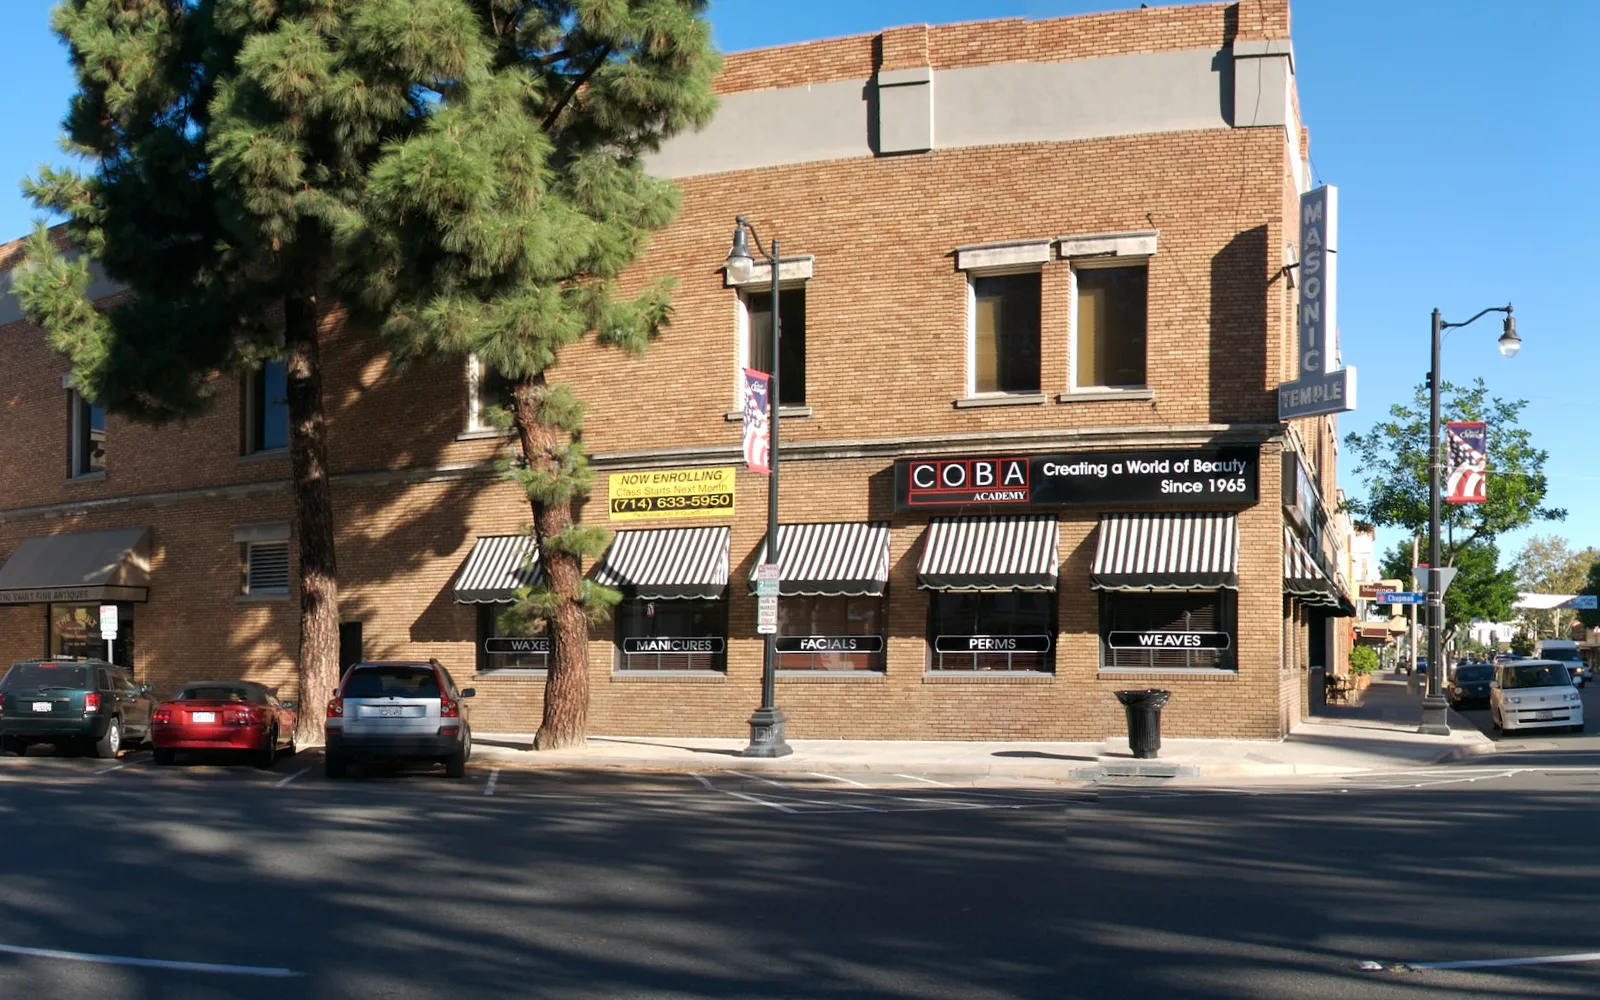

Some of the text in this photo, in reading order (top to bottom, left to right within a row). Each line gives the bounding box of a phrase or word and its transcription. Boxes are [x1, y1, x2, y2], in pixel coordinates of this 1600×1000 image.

[1303, 200, 1322, 372] MASONIC
[1281, 381, 1343, 408] TEMPLE
[913, 461, 1026, 488] COBA
[1043, 459, 1246, 478] Creating a World of Beauty
[621, 470, 723, 485] NOW ENROLLING
[616, 483, 728, 497] Class Starts Next Month
[1161, 479, 1246, 493] Since 1965
[974, 490, 1026, 501] ACADEMY
[614, 495, 730, 512] (714) 633-5950
[13, 592, 34, 601] VAULT
[54, 590, 88, 600] ANTIQUES
[636, 640, 712, 651] MANICURES
[800, 638, 857, 650] FACIALS
[969, 638, 1017, 650] PERMS
[1139, 635, 1201, 647] WEAVES
